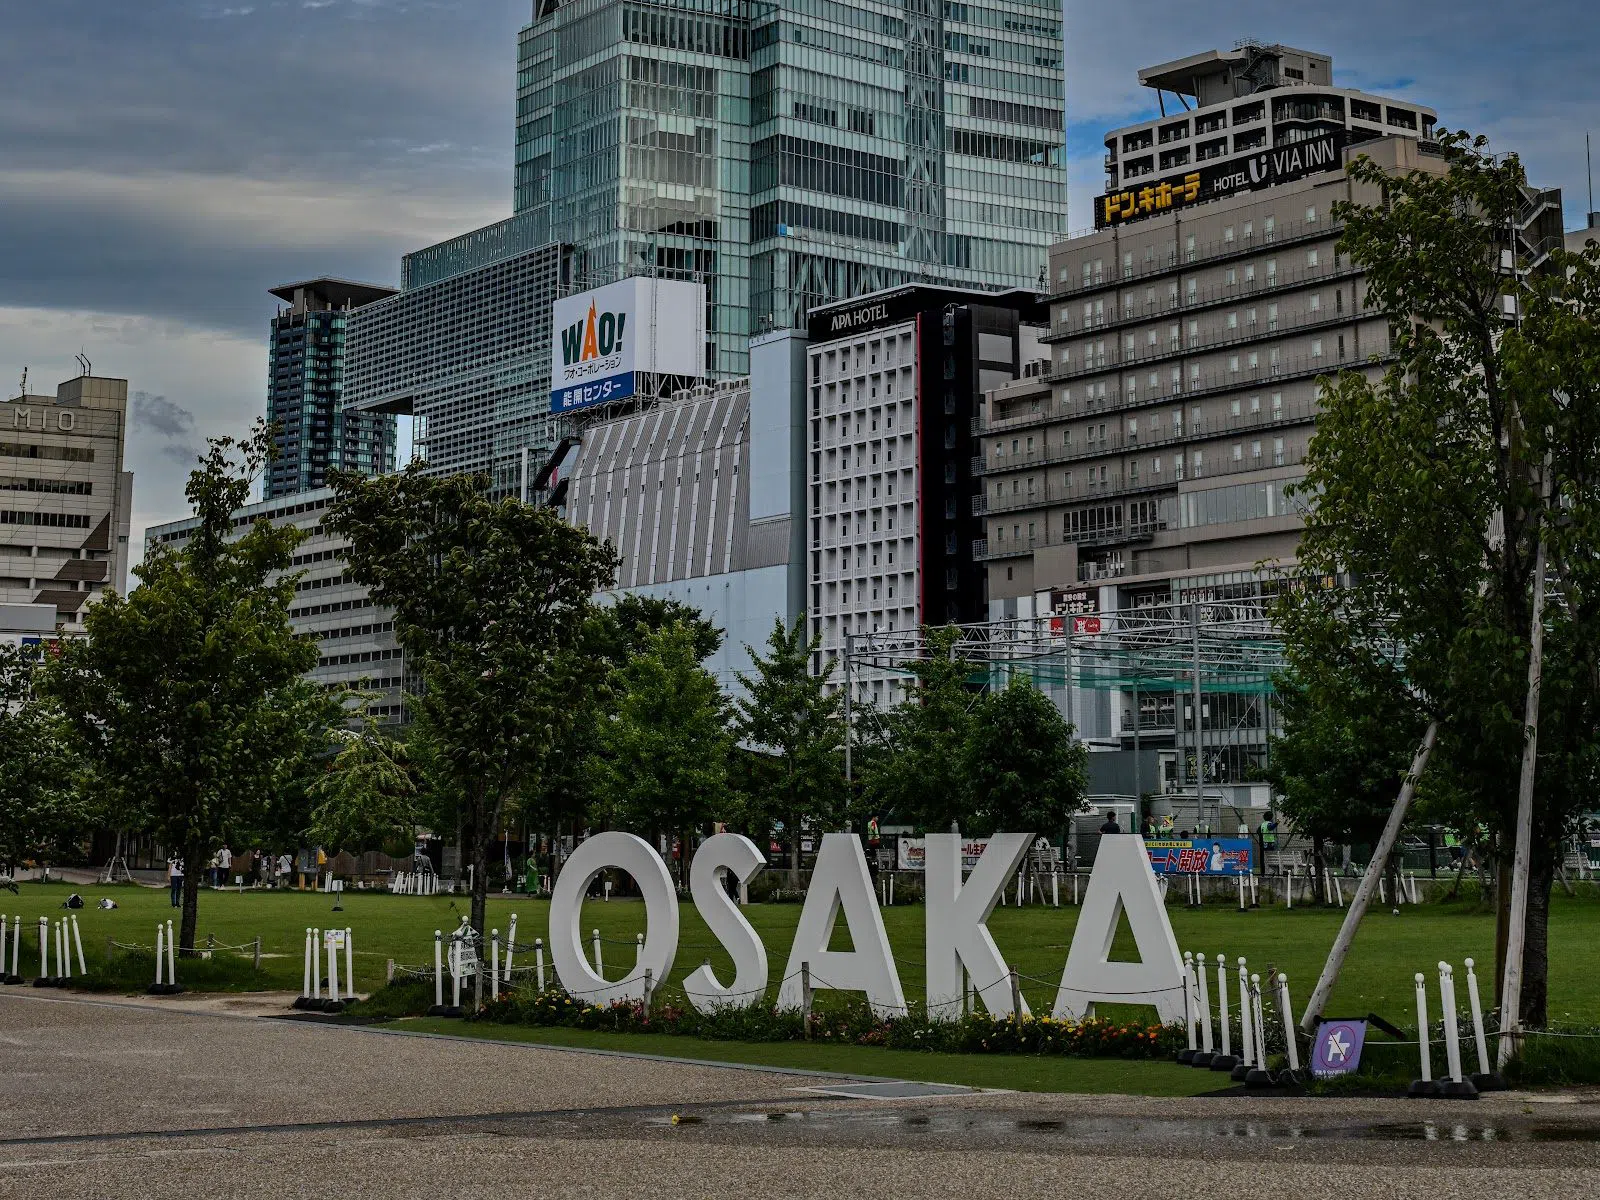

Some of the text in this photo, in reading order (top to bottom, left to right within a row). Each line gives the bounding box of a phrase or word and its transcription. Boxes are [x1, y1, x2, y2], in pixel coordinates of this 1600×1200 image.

[1213, 171, 1249, 193] HOTEL
[1272, 147, 1303, 176] VIA
[1304, 137, 1335, 168] INN
[561, 296, 626, 366] WAO!
[831, 303, 889, 332] APA HOTEL
[562, 380, 622, 408] 能開センター
[13, 407, 75, 432] MIO
[548, 830, 1192, 1026] OSAKA
